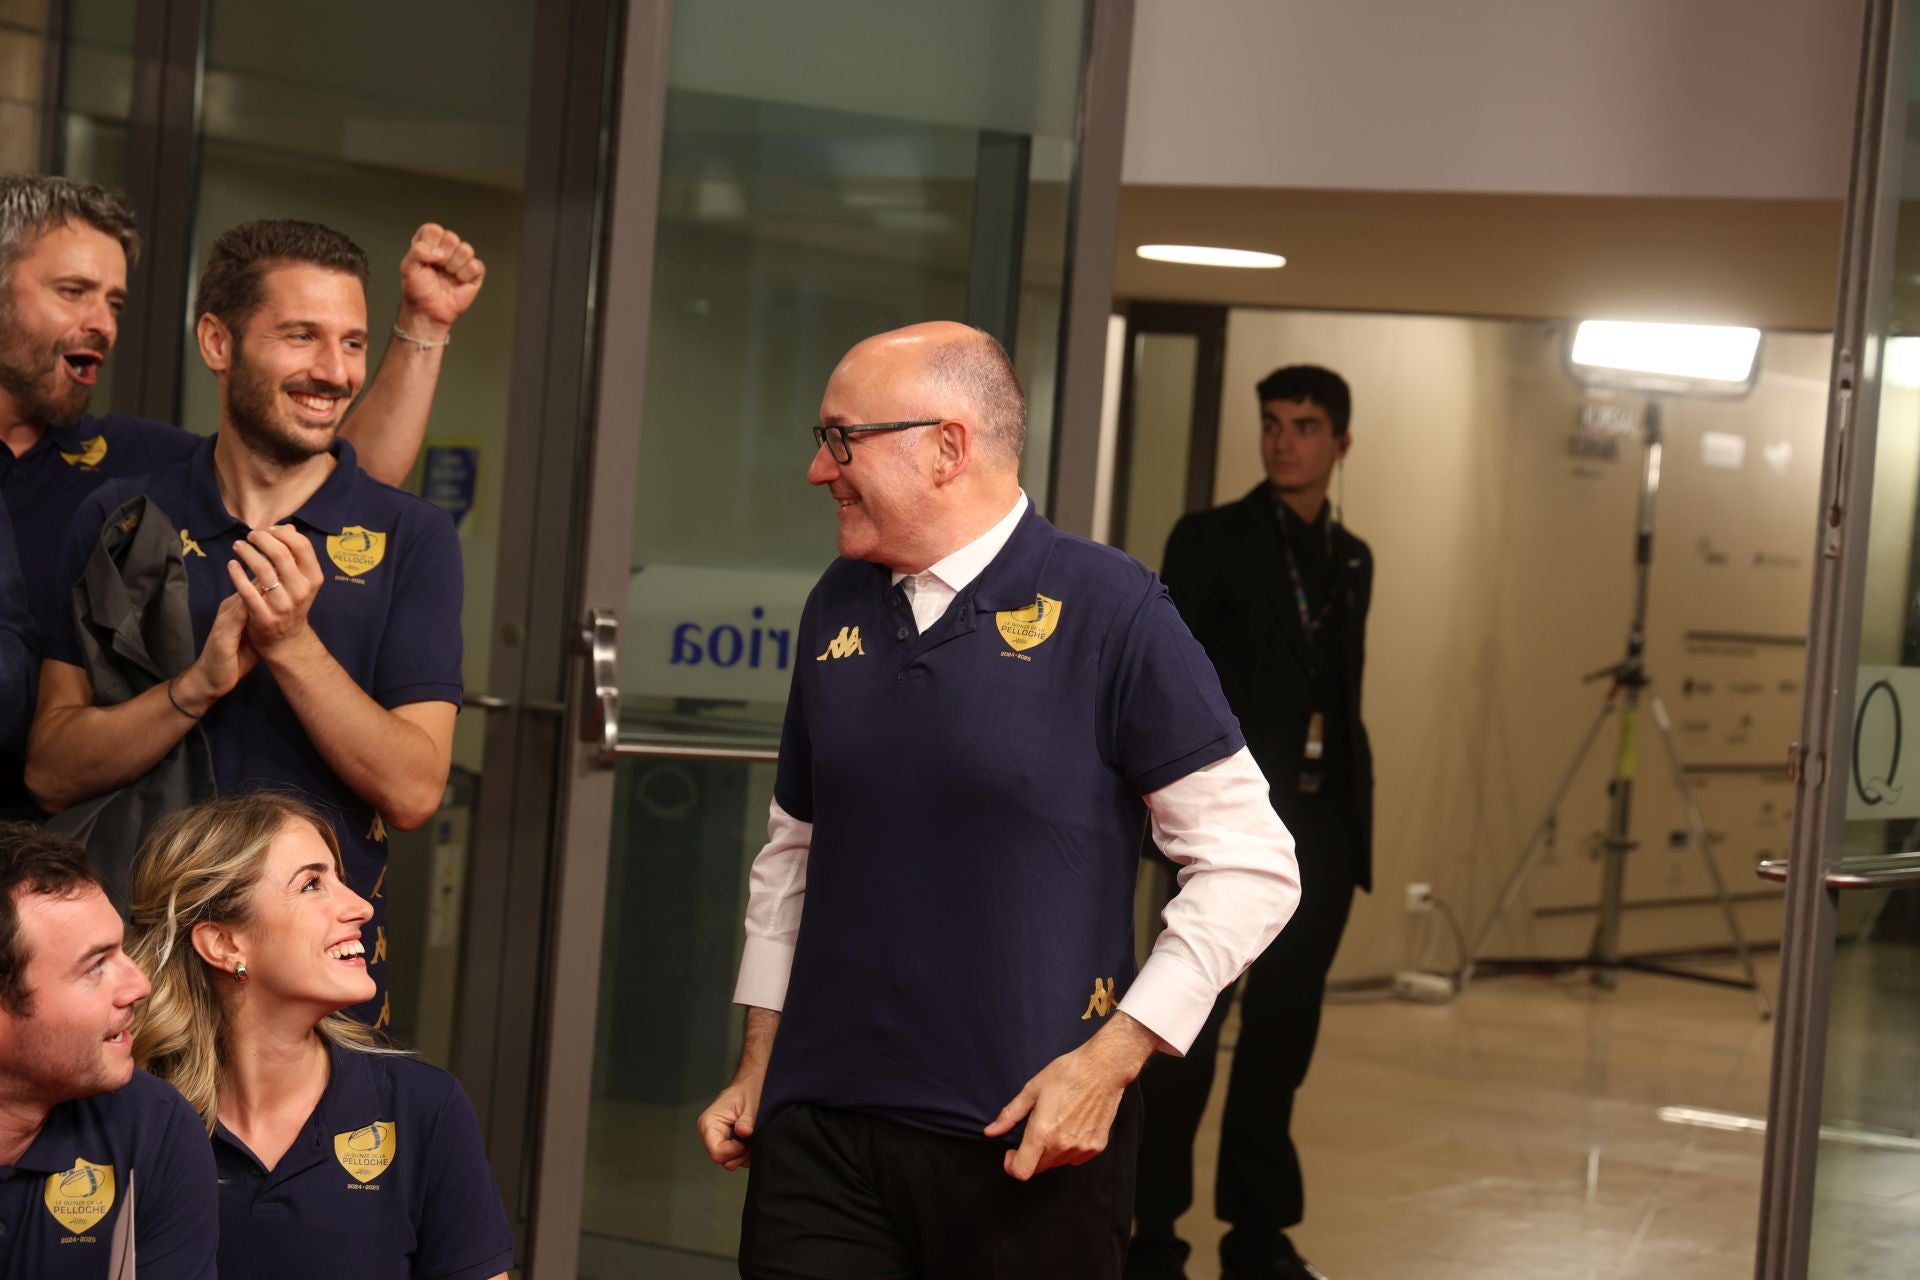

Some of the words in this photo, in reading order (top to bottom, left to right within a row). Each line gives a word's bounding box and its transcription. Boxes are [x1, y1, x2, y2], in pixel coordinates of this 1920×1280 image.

[1001, 625, 1046, 640] PELLOCHE
[342, 1157, 388, 1166] PELLOCHE
[53, 1205, 106, 1214] PELLOCHE
